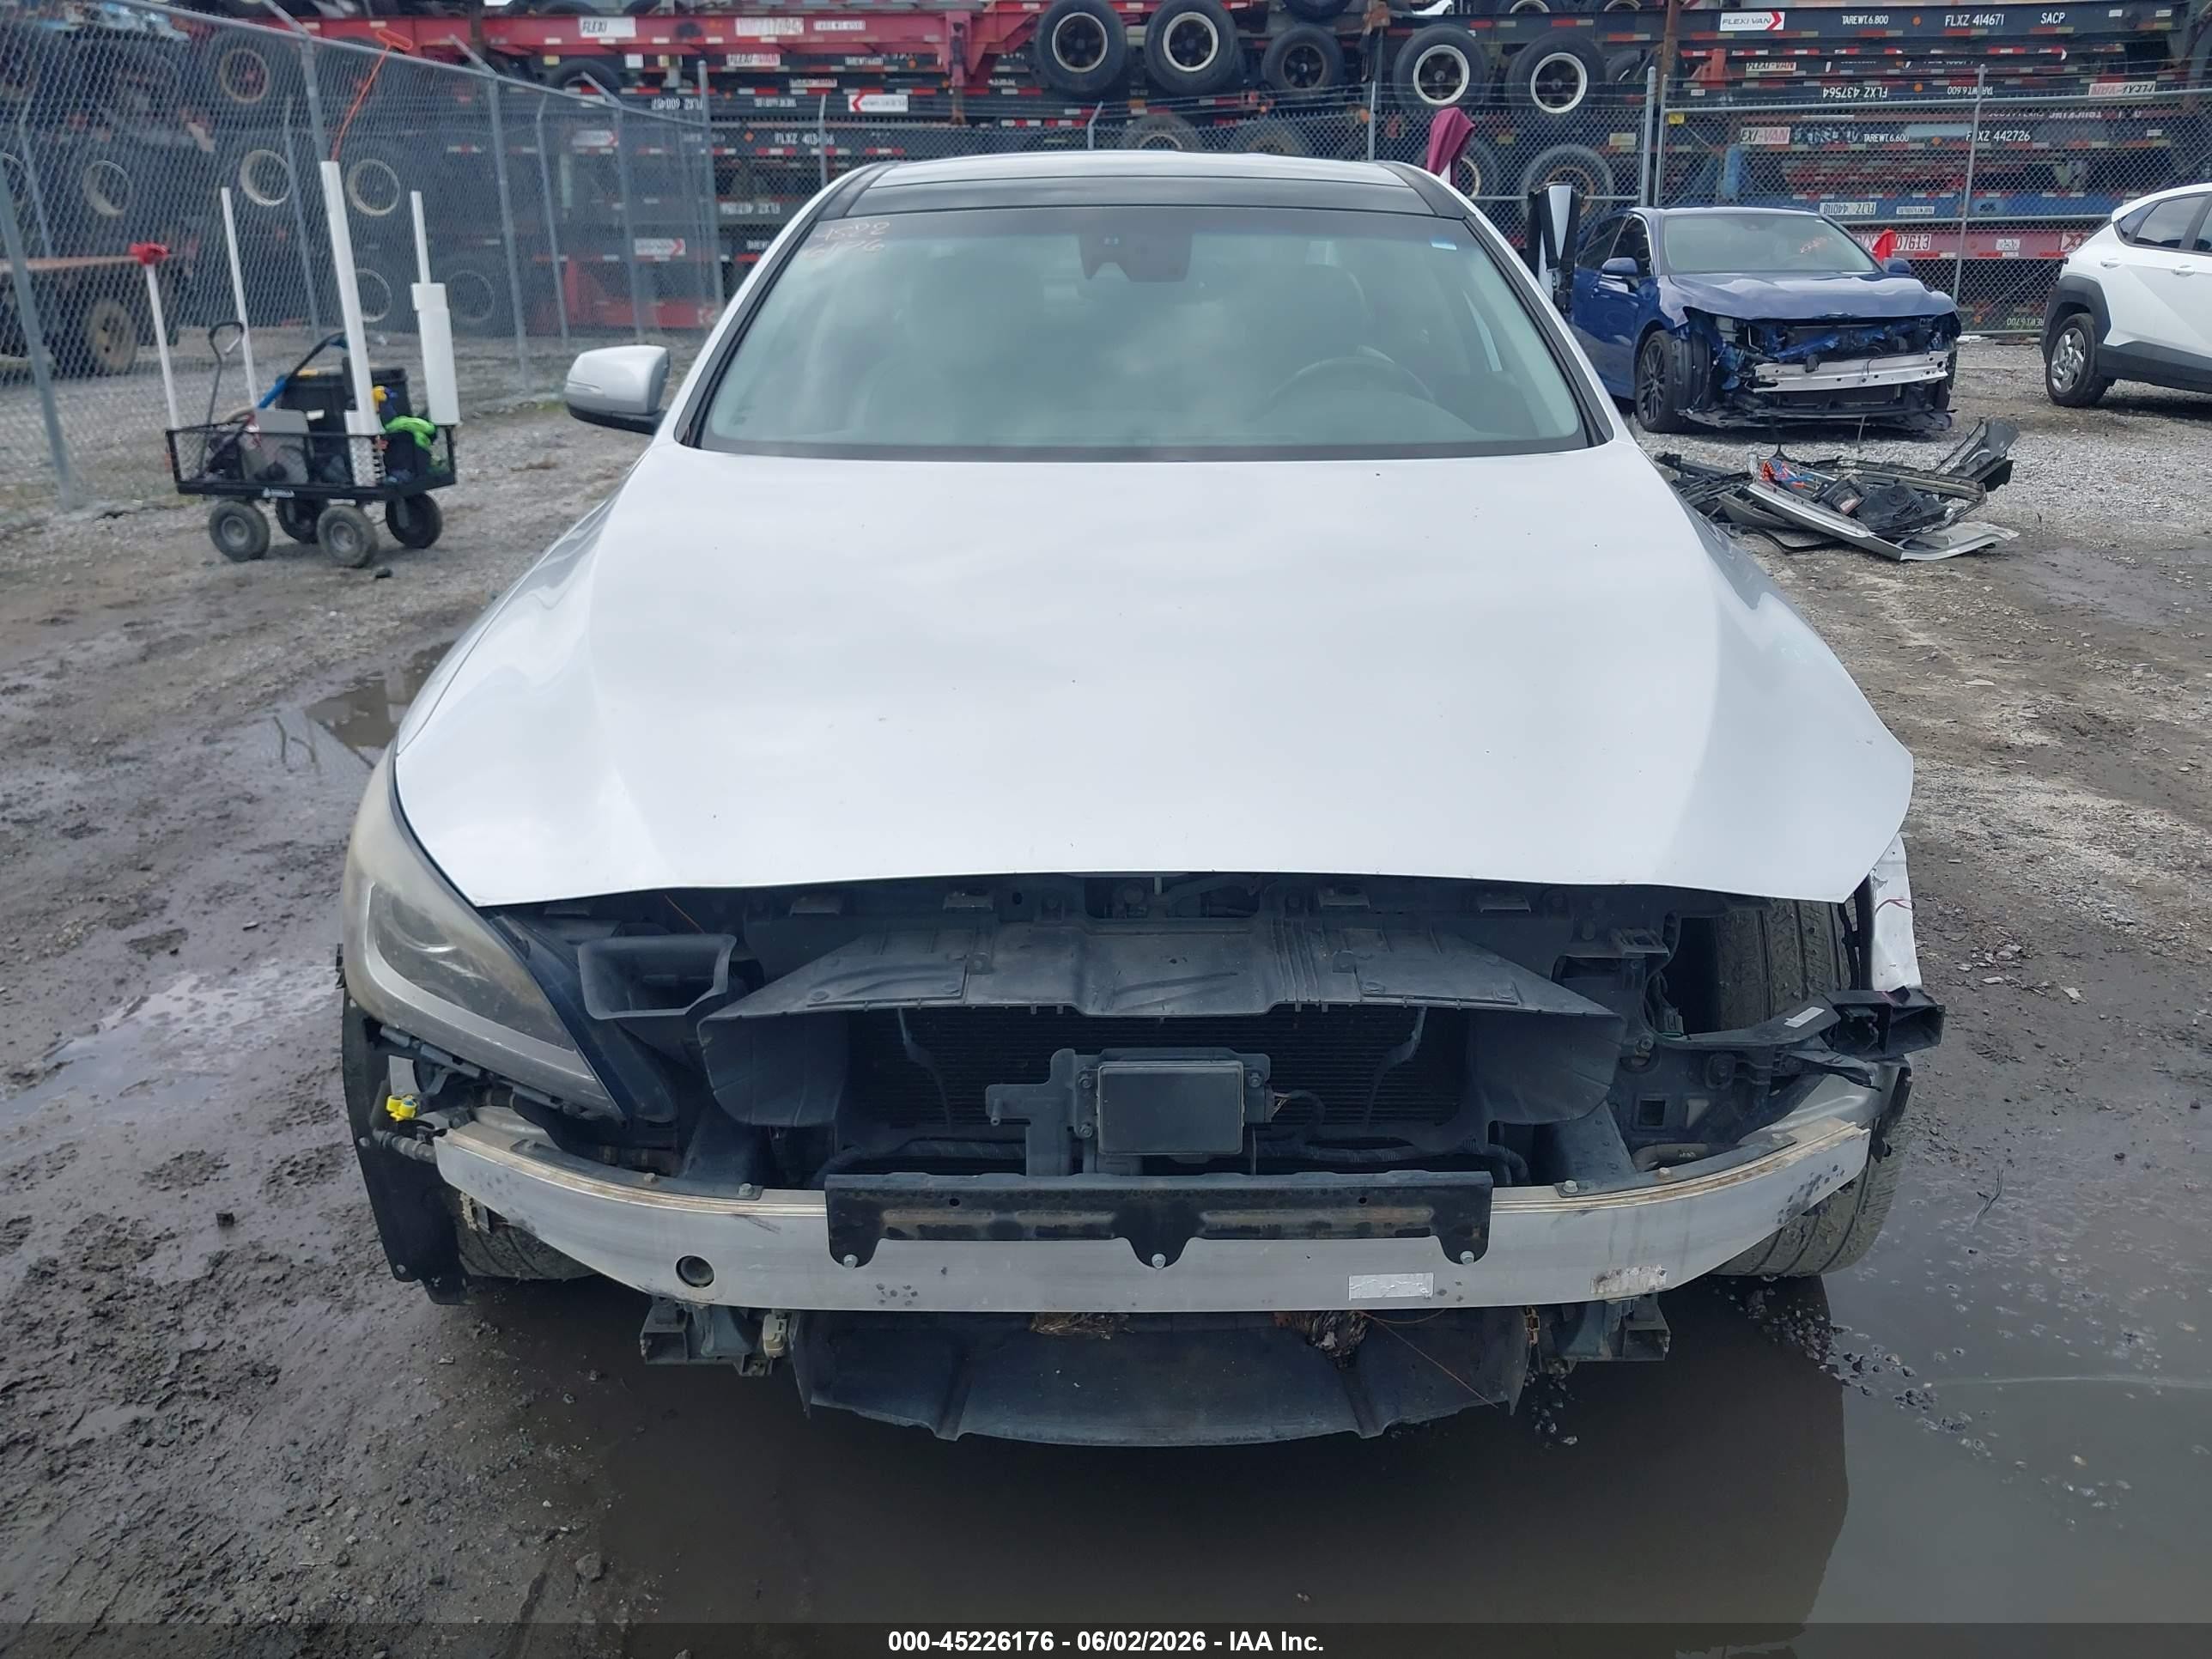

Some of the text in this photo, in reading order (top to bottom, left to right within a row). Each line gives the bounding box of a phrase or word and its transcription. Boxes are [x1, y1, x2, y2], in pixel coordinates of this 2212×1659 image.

[1944, 13, 2005, 27] FLXZ 414671
[2040, 11, 2066, 24] SACP
[1822, 87, 1888, 99] FLXZ 437564
[1966, 130, 2031, 143] FXZ 442726
